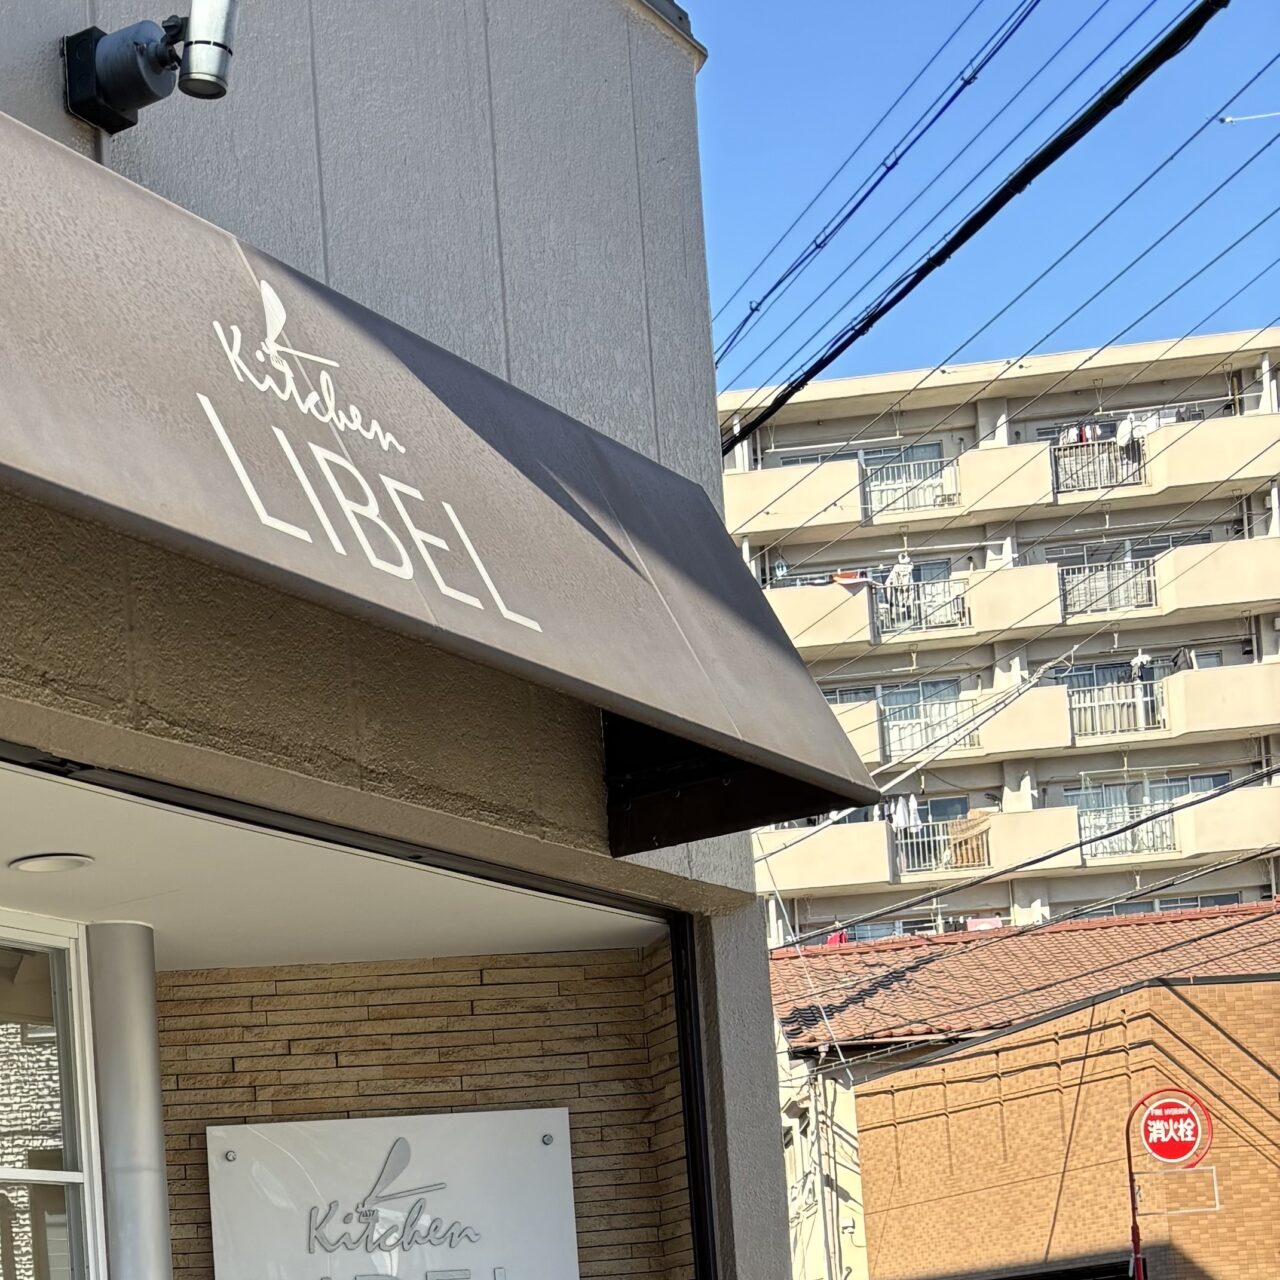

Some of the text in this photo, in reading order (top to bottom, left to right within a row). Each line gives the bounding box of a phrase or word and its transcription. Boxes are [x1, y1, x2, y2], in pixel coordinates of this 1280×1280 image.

[212, 318, 407, 454] Kitchen
[195, 392, 543, 633] LIBEL
[1147, 1118, 1196, 1143] 消火栓
[307, 1197, 482, 1254] Kitchen
